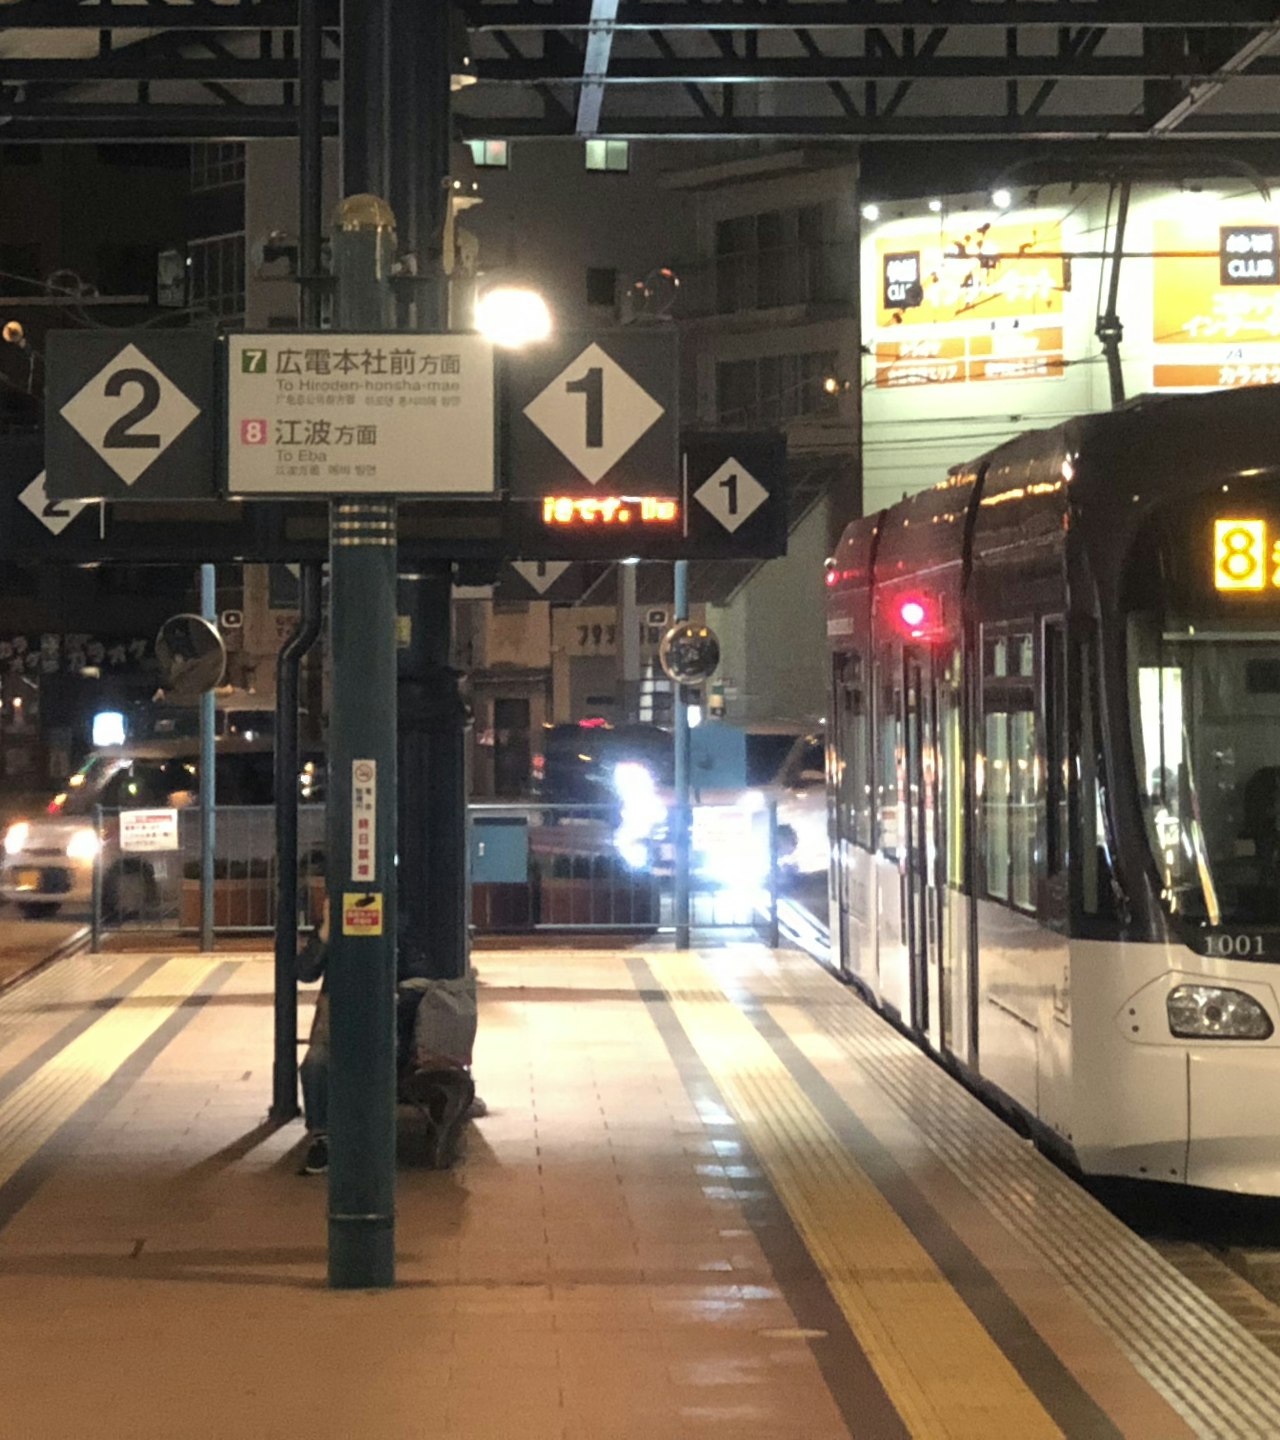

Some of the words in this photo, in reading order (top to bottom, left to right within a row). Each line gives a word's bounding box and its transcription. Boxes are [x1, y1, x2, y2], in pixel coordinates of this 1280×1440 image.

[244, 351, 263, 372] 7
[275, 348, 461, 375] 広電本社前方面
[276, 379, 294, 392] To
[299, 379, 461, 392] Hiroden-honsha-mae
[102, 367, 162, 450] 2
[565, 367, 606, 449] 1
[244, 421, 263, 442] 8
[275, 418, 378, 446] 江波方面
[276, 449, 294, 462] To
[299, 449, 328, 462] Eba
[719, 474, 738, 515] 1
[1221, 527, 1257, 581] 8
[1204, 934, 1267, 956] 1001
